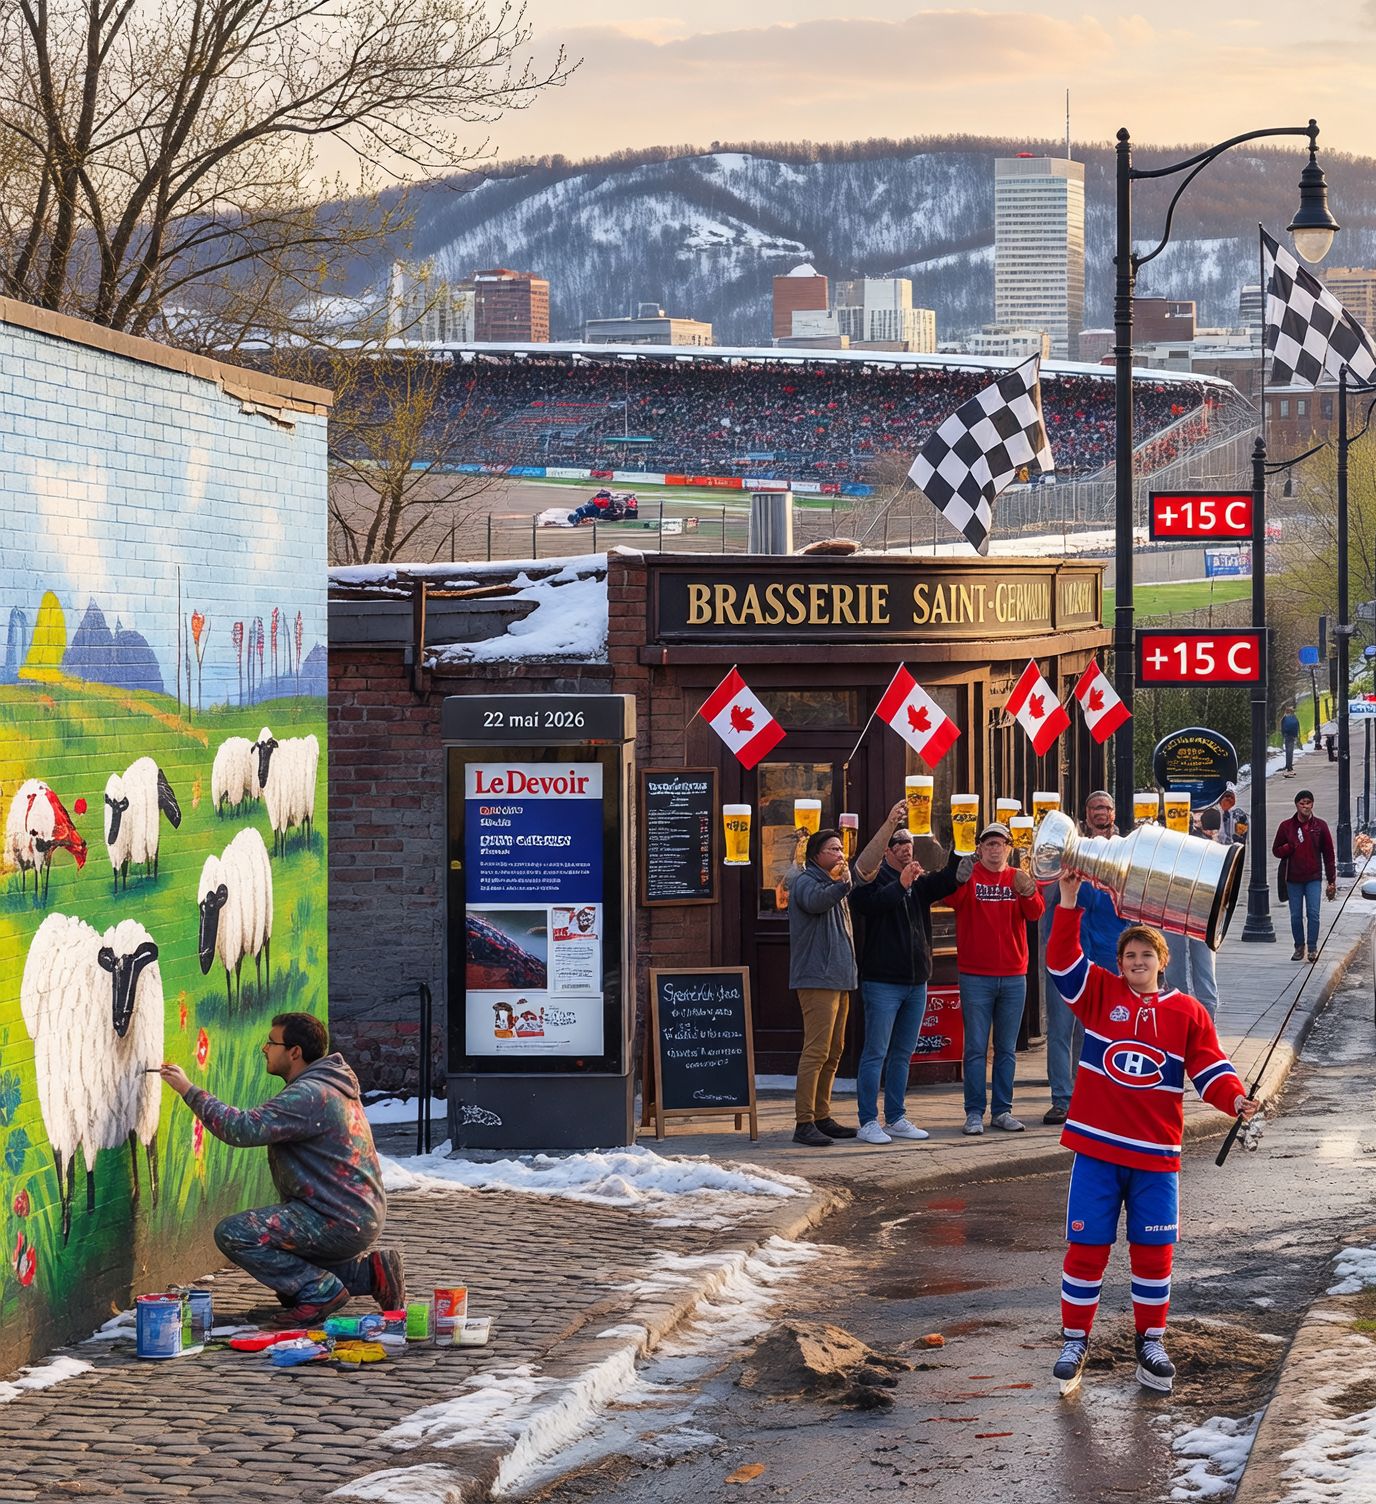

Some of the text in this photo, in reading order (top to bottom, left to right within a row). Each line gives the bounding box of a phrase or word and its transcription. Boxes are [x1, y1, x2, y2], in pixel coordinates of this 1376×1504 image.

[1157, 501, 1247, 530] +15 C
[686, 583, 890, 625] BRASSERIE
[1145, 641, 1252, 676] +15 C
[483, 711, 586, 728] 22 mai 2026
